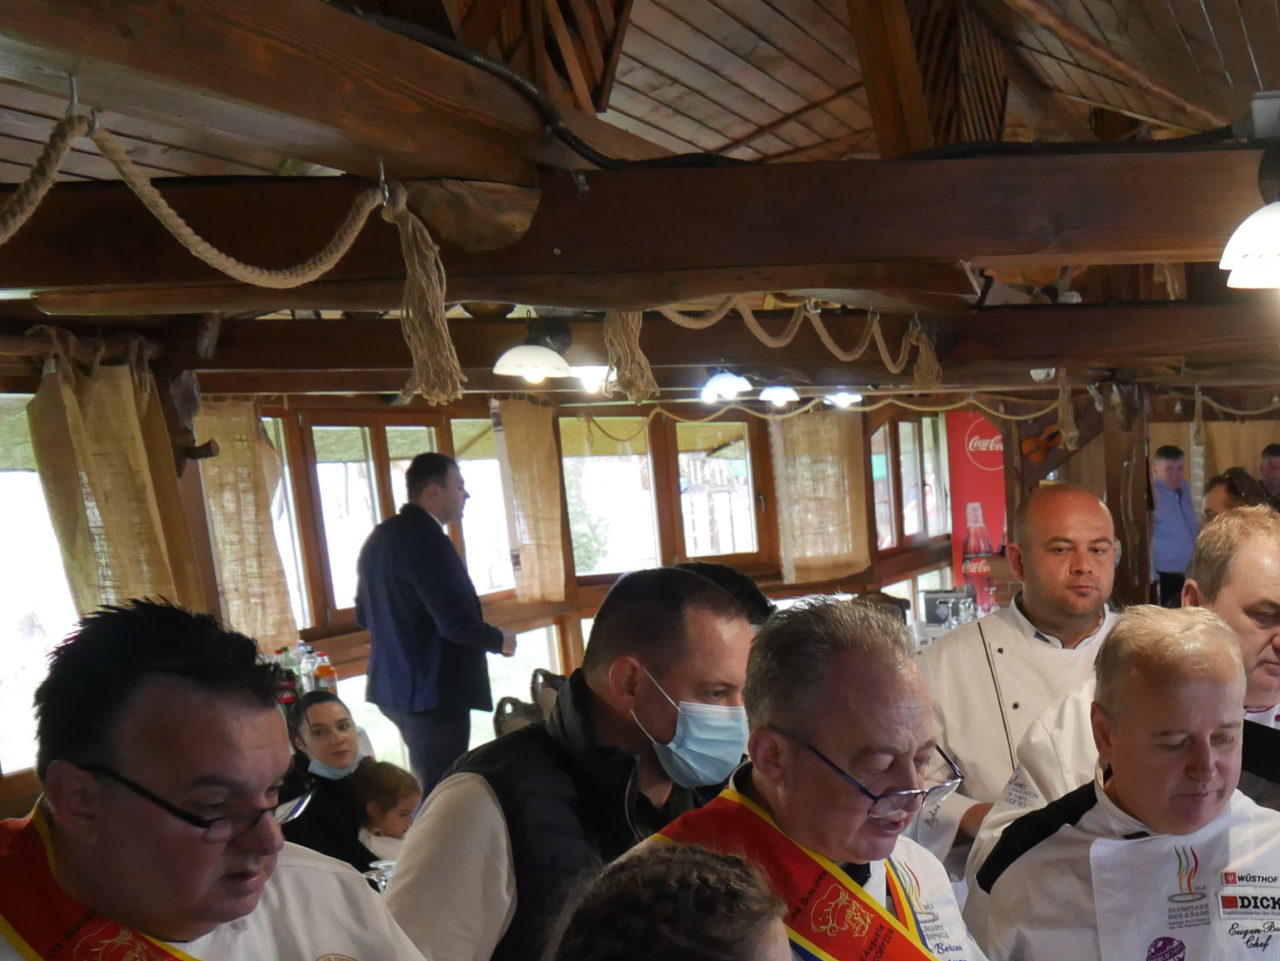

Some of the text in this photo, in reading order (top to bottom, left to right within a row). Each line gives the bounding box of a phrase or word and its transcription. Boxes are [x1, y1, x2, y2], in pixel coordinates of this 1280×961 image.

[1237, 874, 1279, 883] WÜSTHOF
[1228, 922, 1262, 939] Eugen
[1245, 935, 1272, 951] Chef
